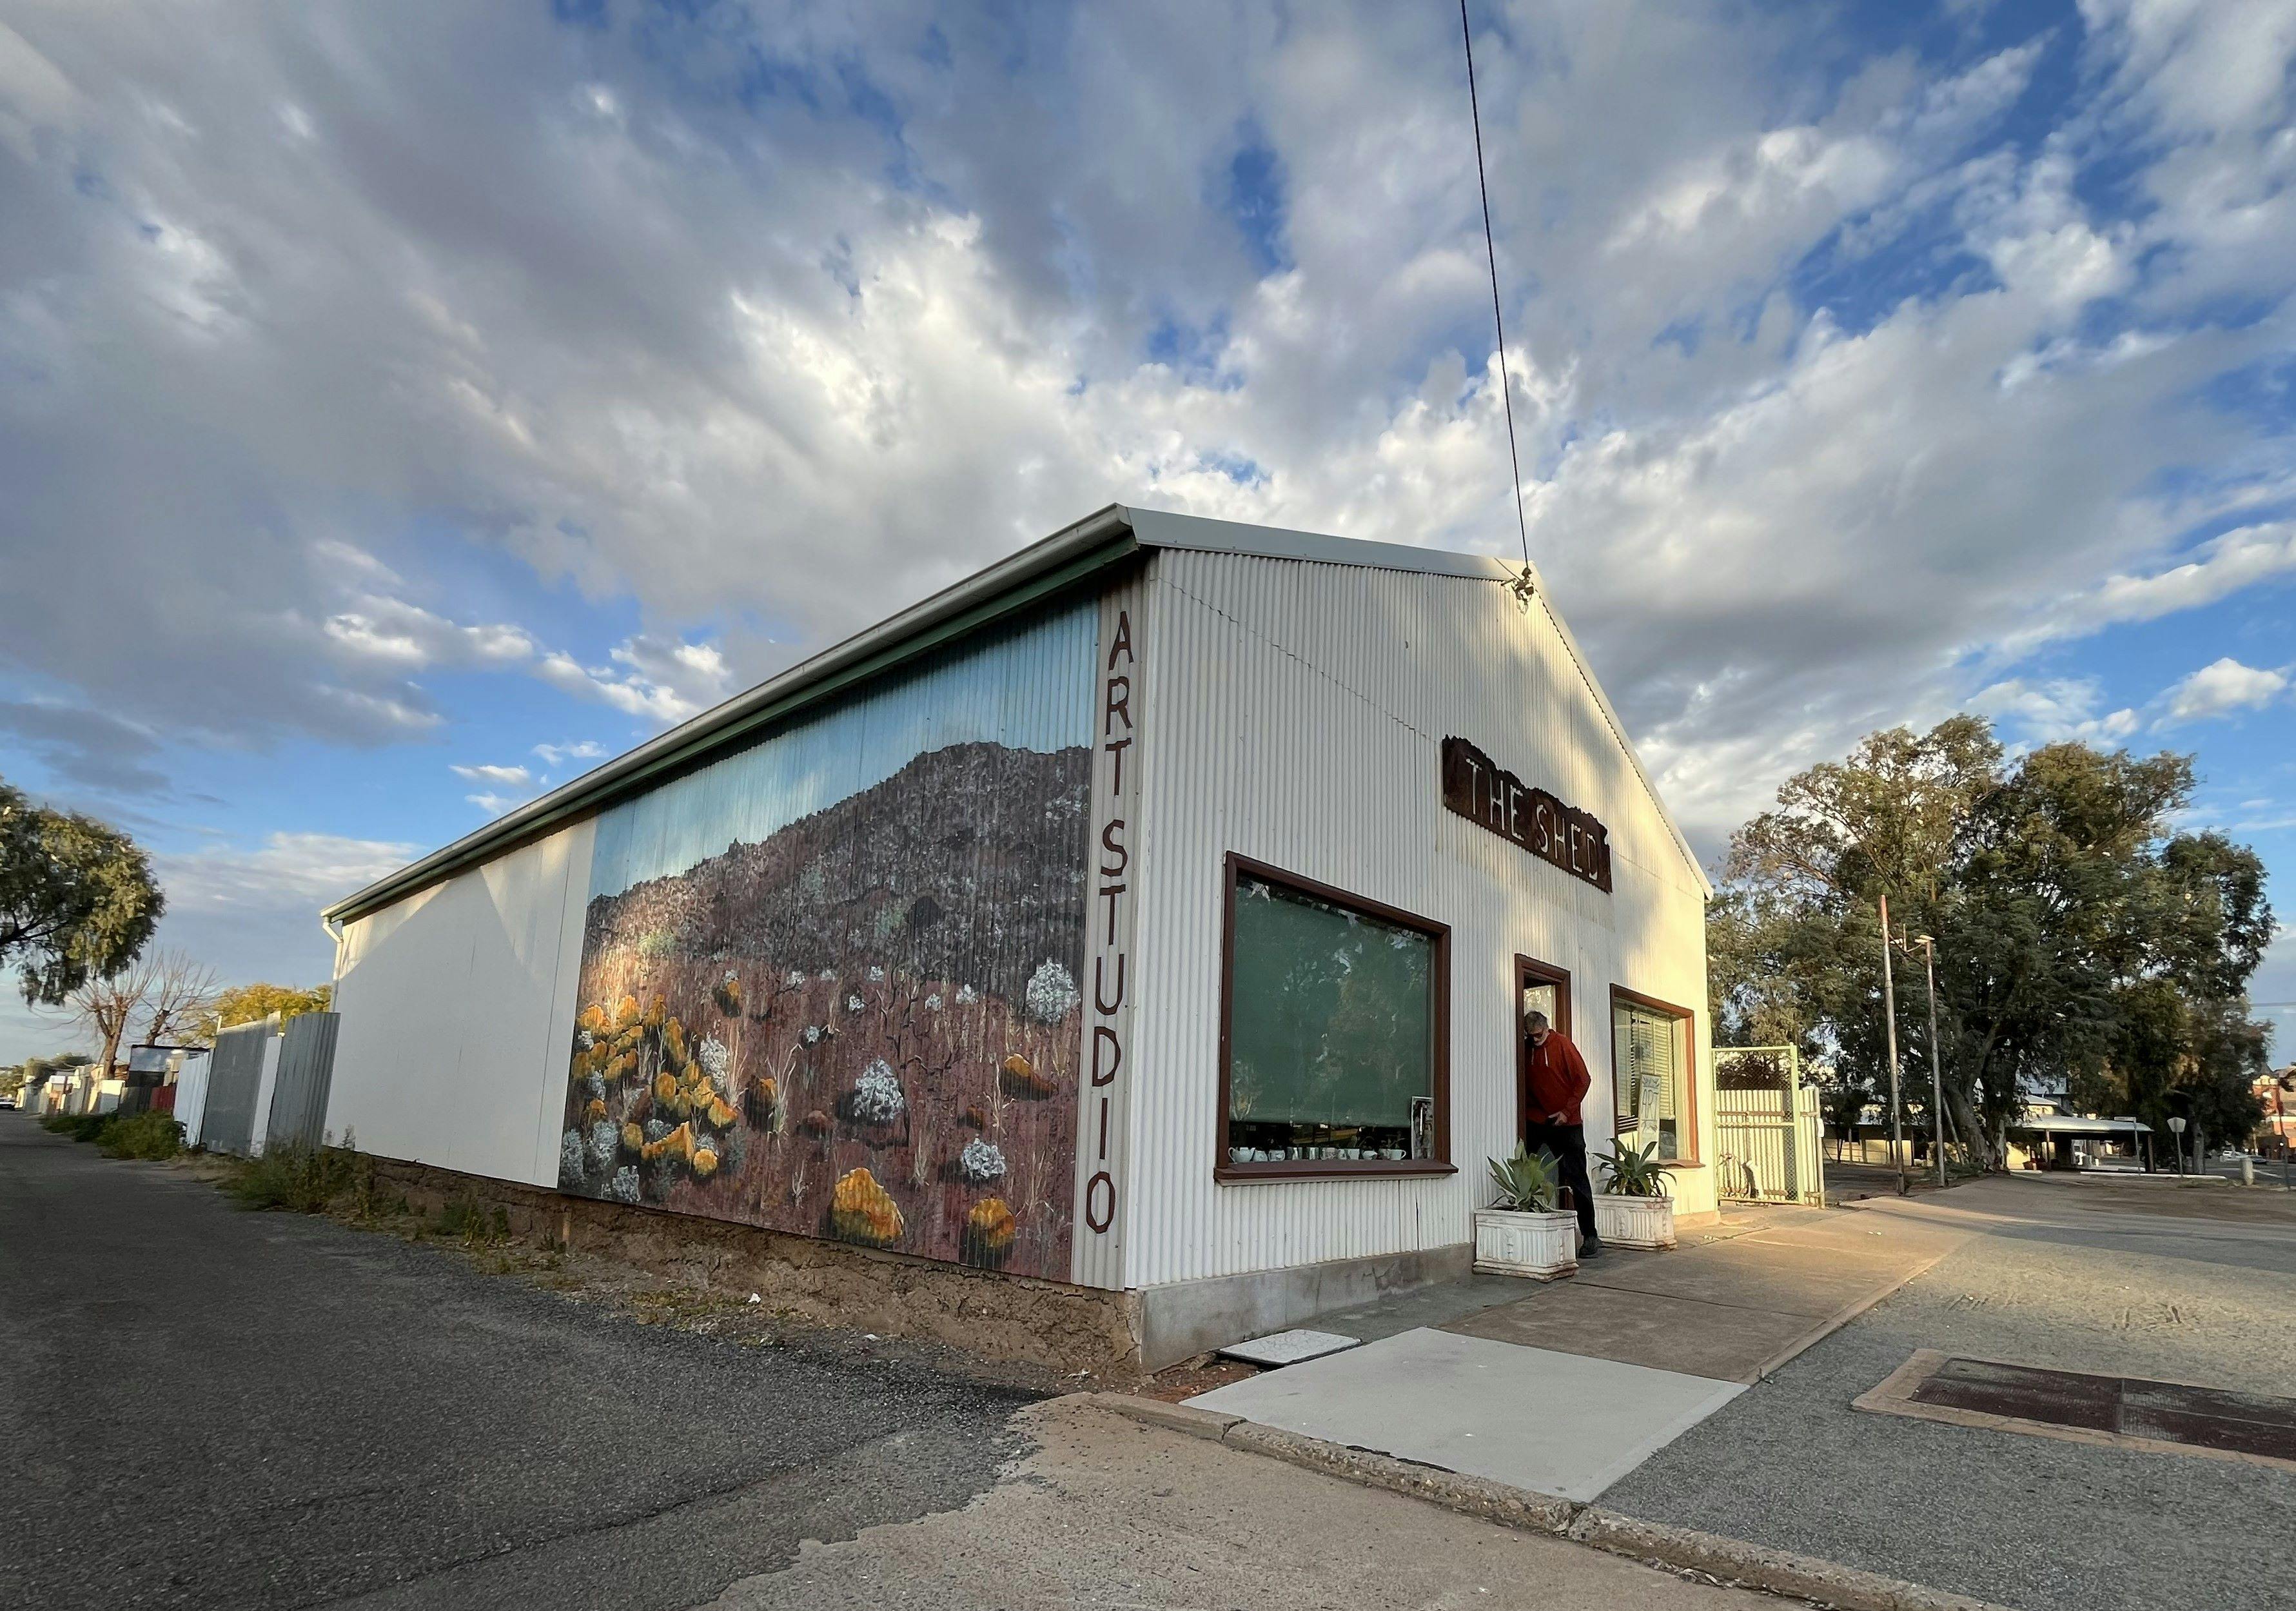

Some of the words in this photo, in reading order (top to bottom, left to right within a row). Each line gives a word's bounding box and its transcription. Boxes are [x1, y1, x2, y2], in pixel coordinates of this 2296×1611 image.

[1105, 611, 1134, 796] ART
[1465, 757, 1525, 842] THE
[1535, 804, 1598, 881] SHED
[1086, 819, 1128, 1234] STUDIO
